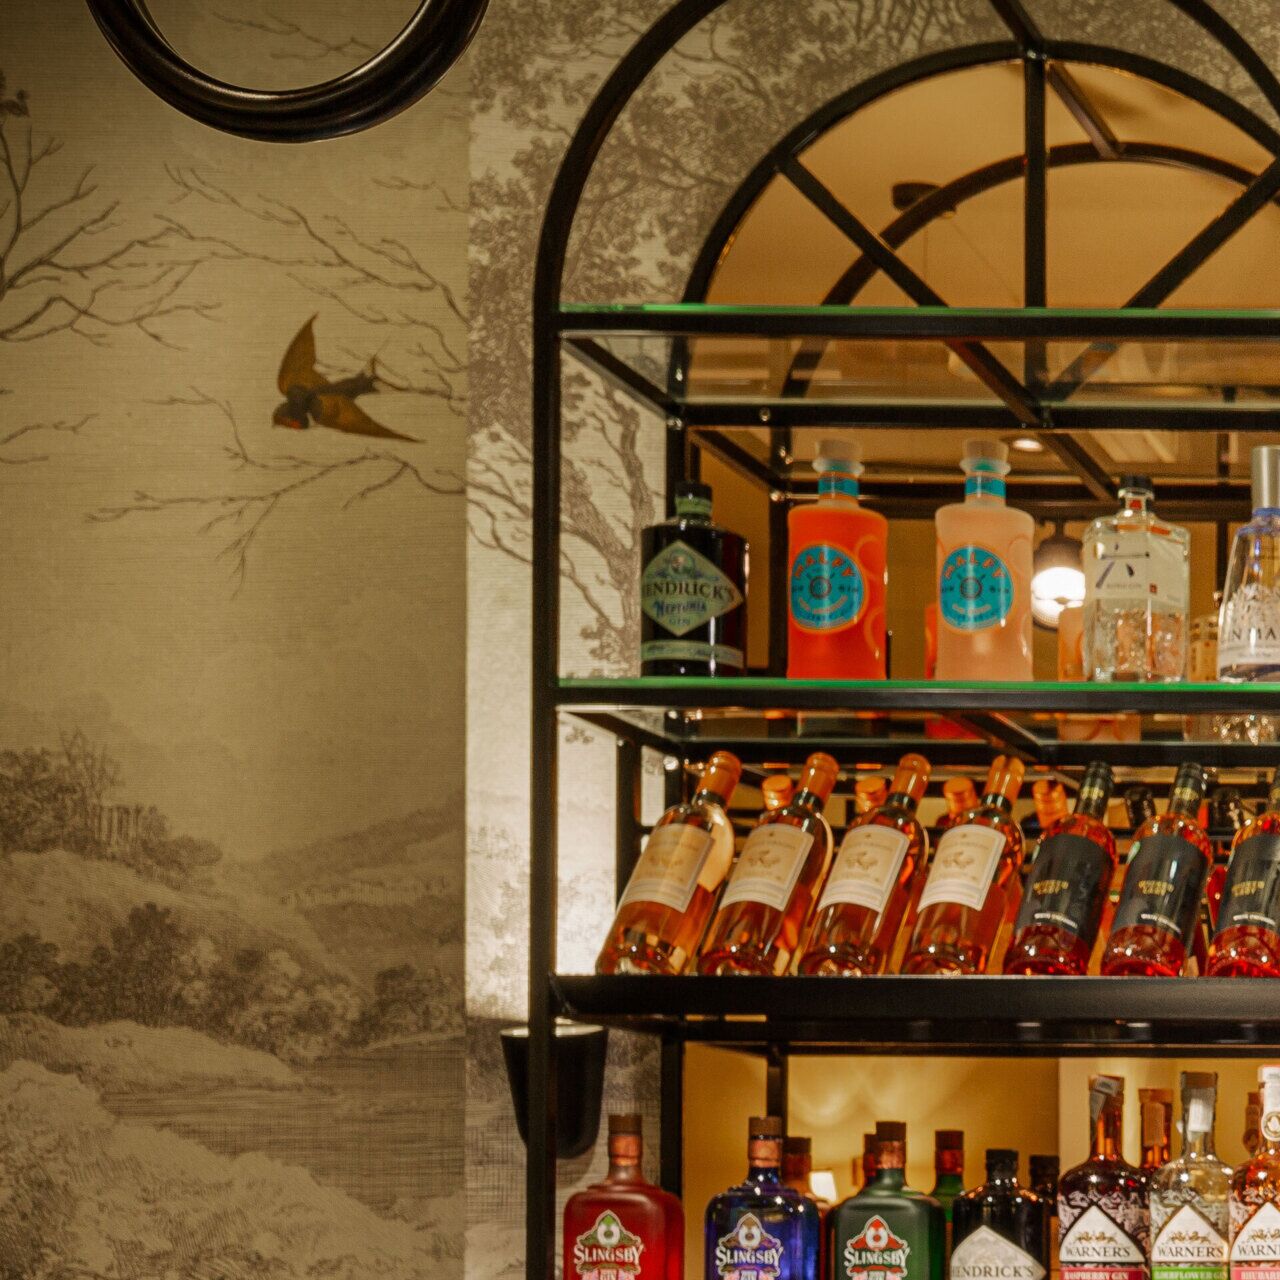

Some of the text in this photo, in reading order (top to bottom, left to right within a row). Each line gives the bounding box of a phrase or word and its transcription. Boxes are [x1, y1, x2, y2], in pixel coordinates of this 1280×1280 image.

[573, 1243, 644, 1266] SLINGSBY
[715, 1245, 784, 1269] SLINGSBY
[844, 1247, 911, 1269] SLINGSBY
[1065, 1246, 1131, 1257] WARNER'S
[1158, 1246, 1224, 1258] WARNER'S
